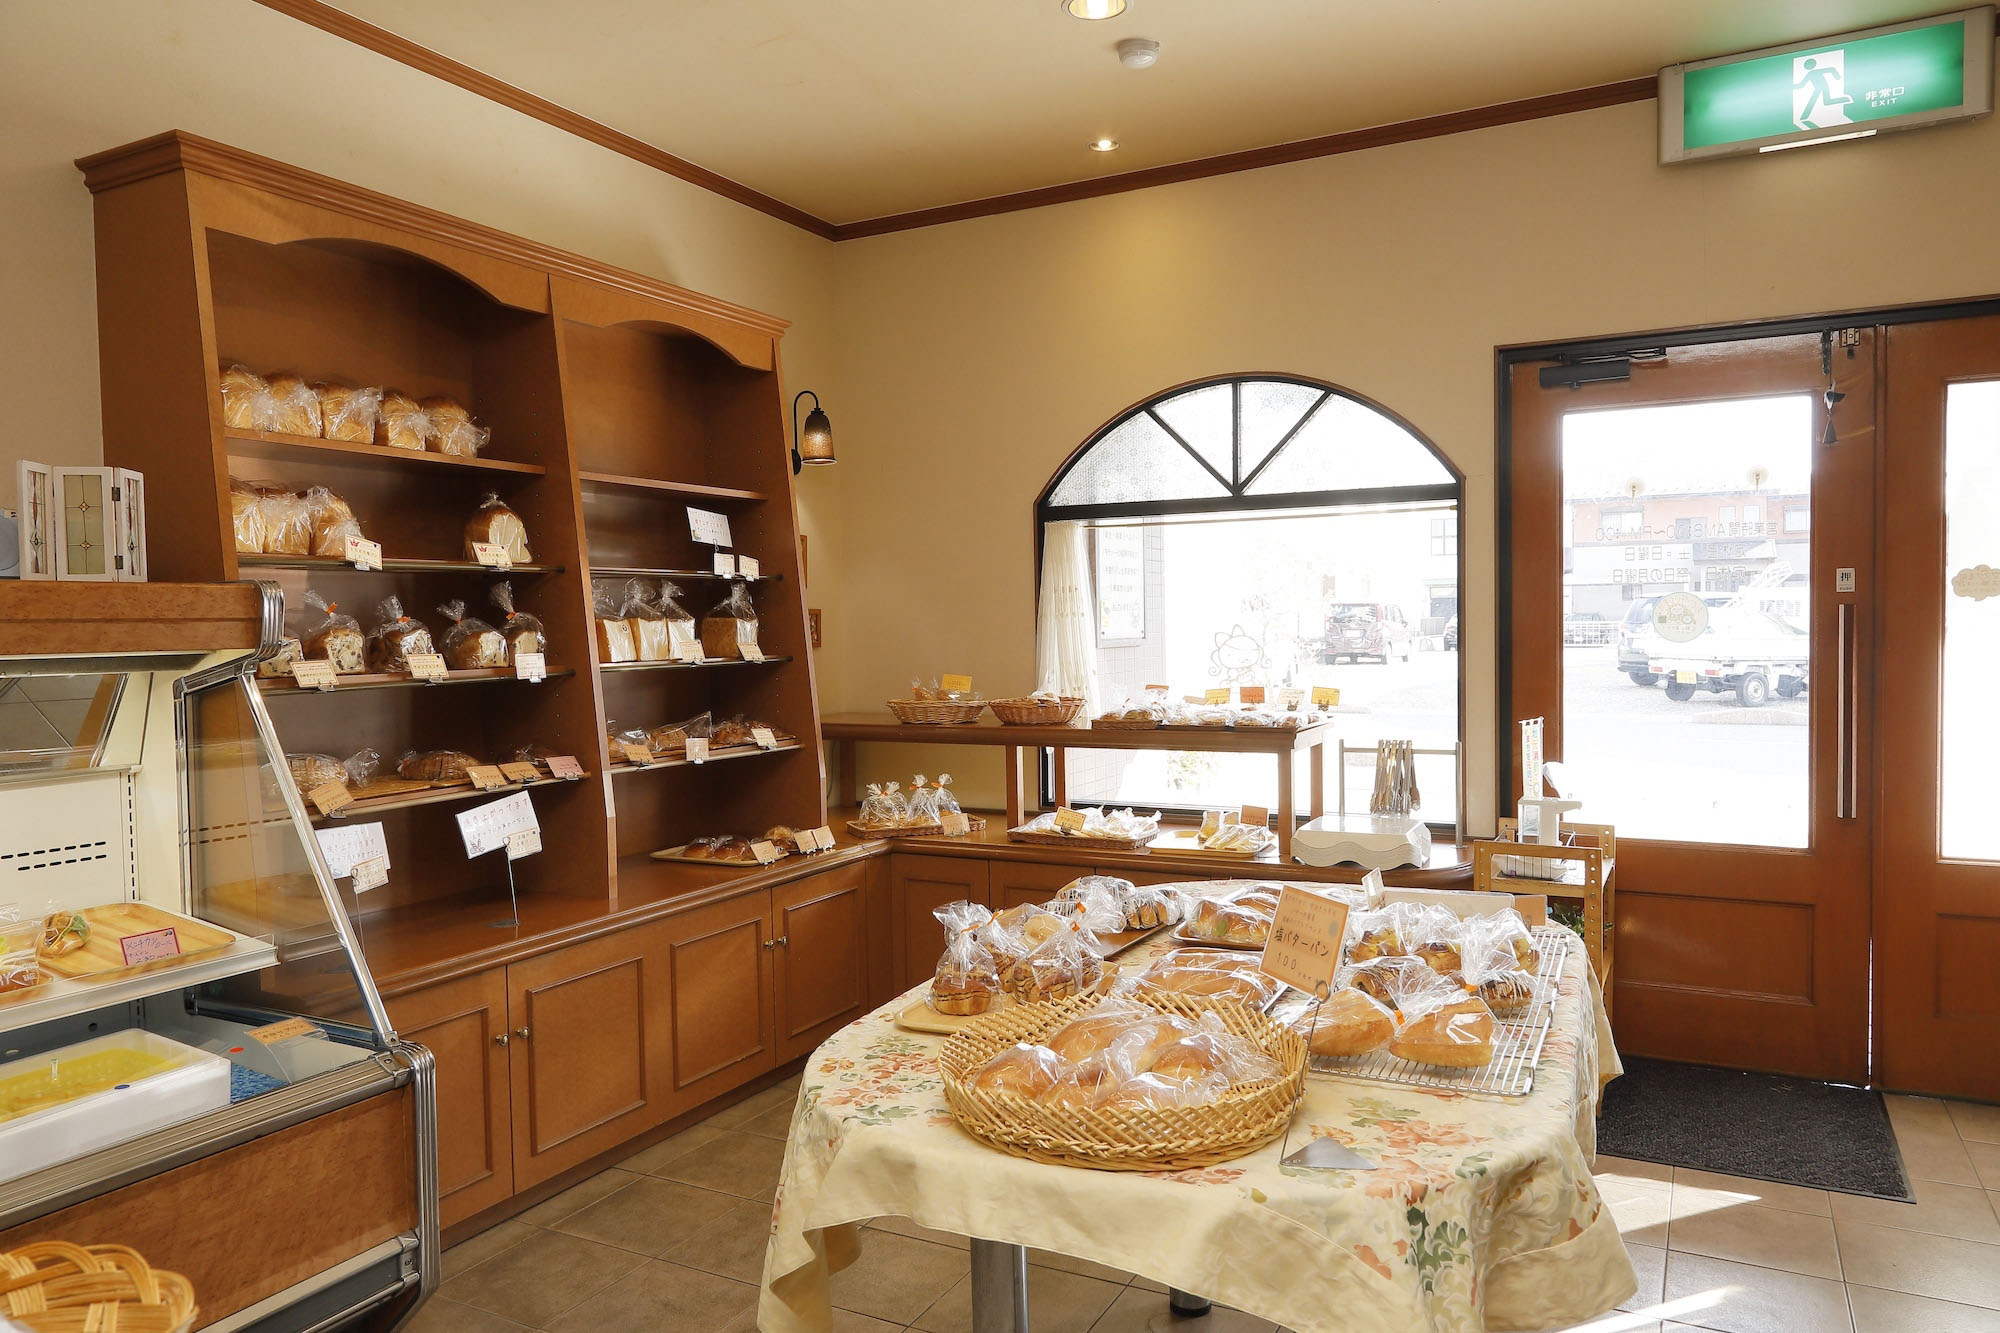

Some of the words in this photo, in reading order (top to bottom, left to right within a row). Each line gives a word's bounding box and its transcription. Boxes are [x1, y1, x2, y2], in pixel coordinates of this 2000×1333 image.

[1864, 86, 1904, 101] 非常口
[1871, 97, 1897, 108] EXIT
[1274, 926, 1329, 957] 塩バターパン
